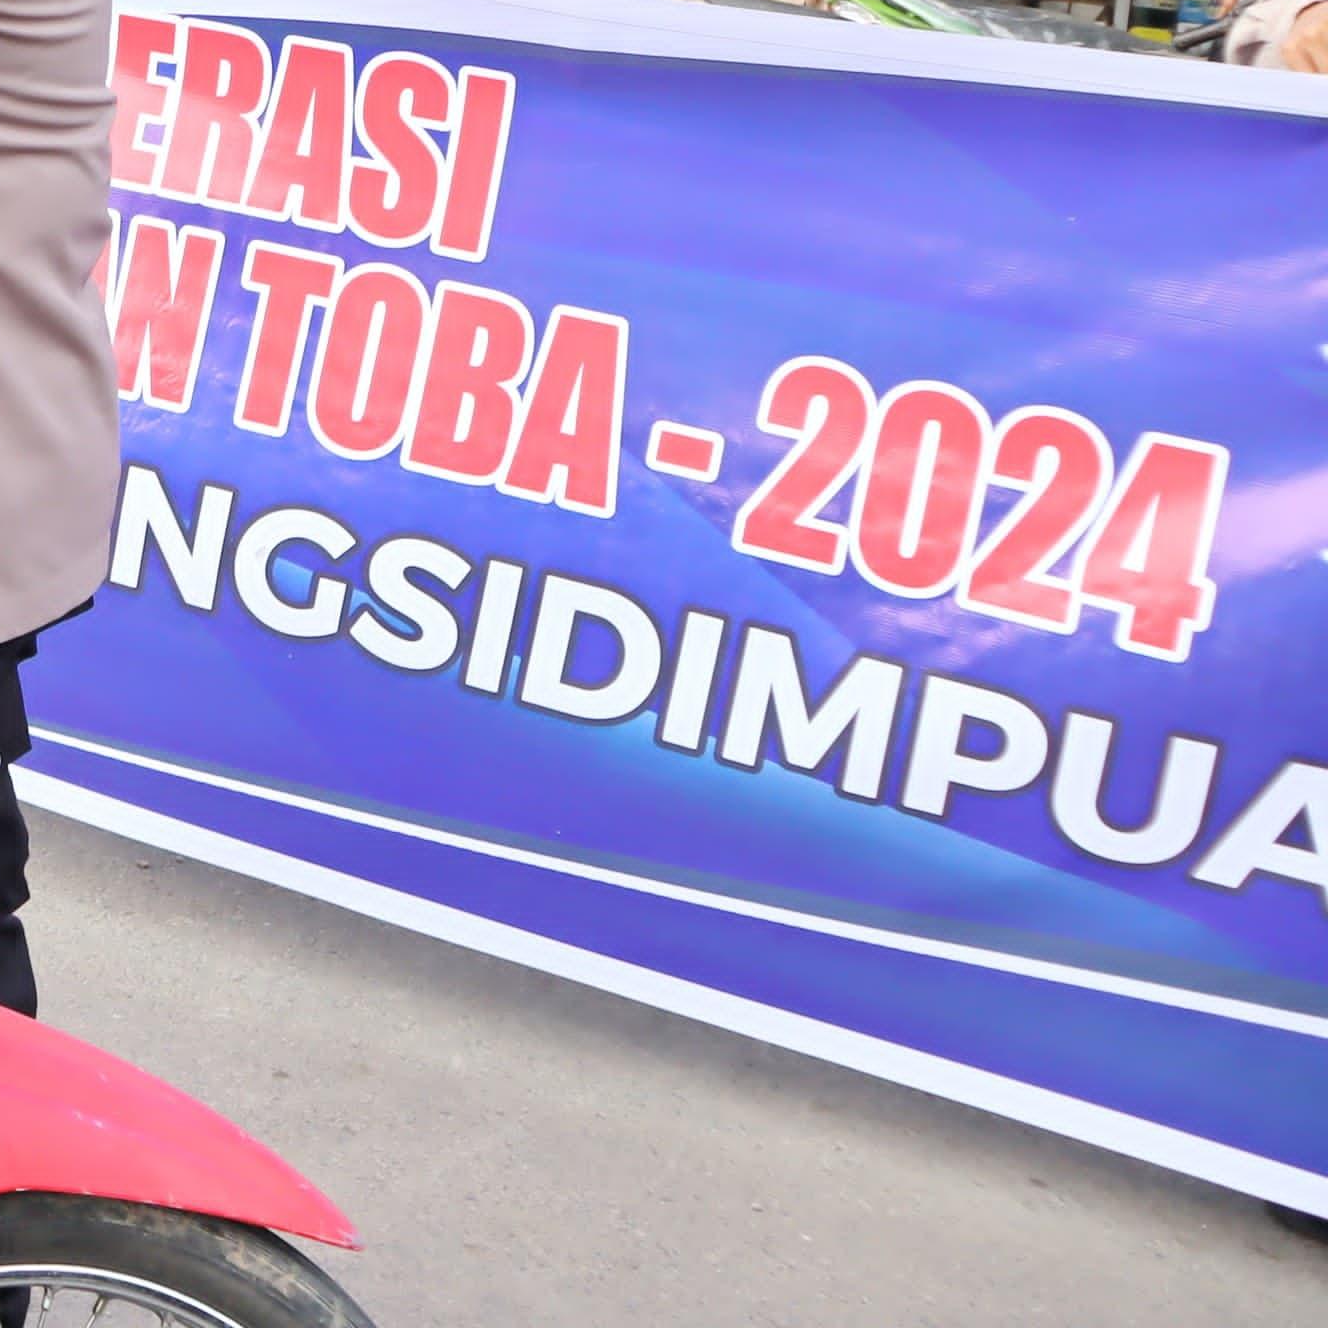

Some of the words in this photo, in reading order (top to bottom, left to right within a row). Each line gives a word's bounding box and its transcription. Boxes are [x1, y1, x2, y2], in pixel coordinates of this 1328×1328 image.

[110, 10, 514, 262] ERASI
[233, 236, 631, 521] TOBA
[733, 353, 1233, 666] 2024
